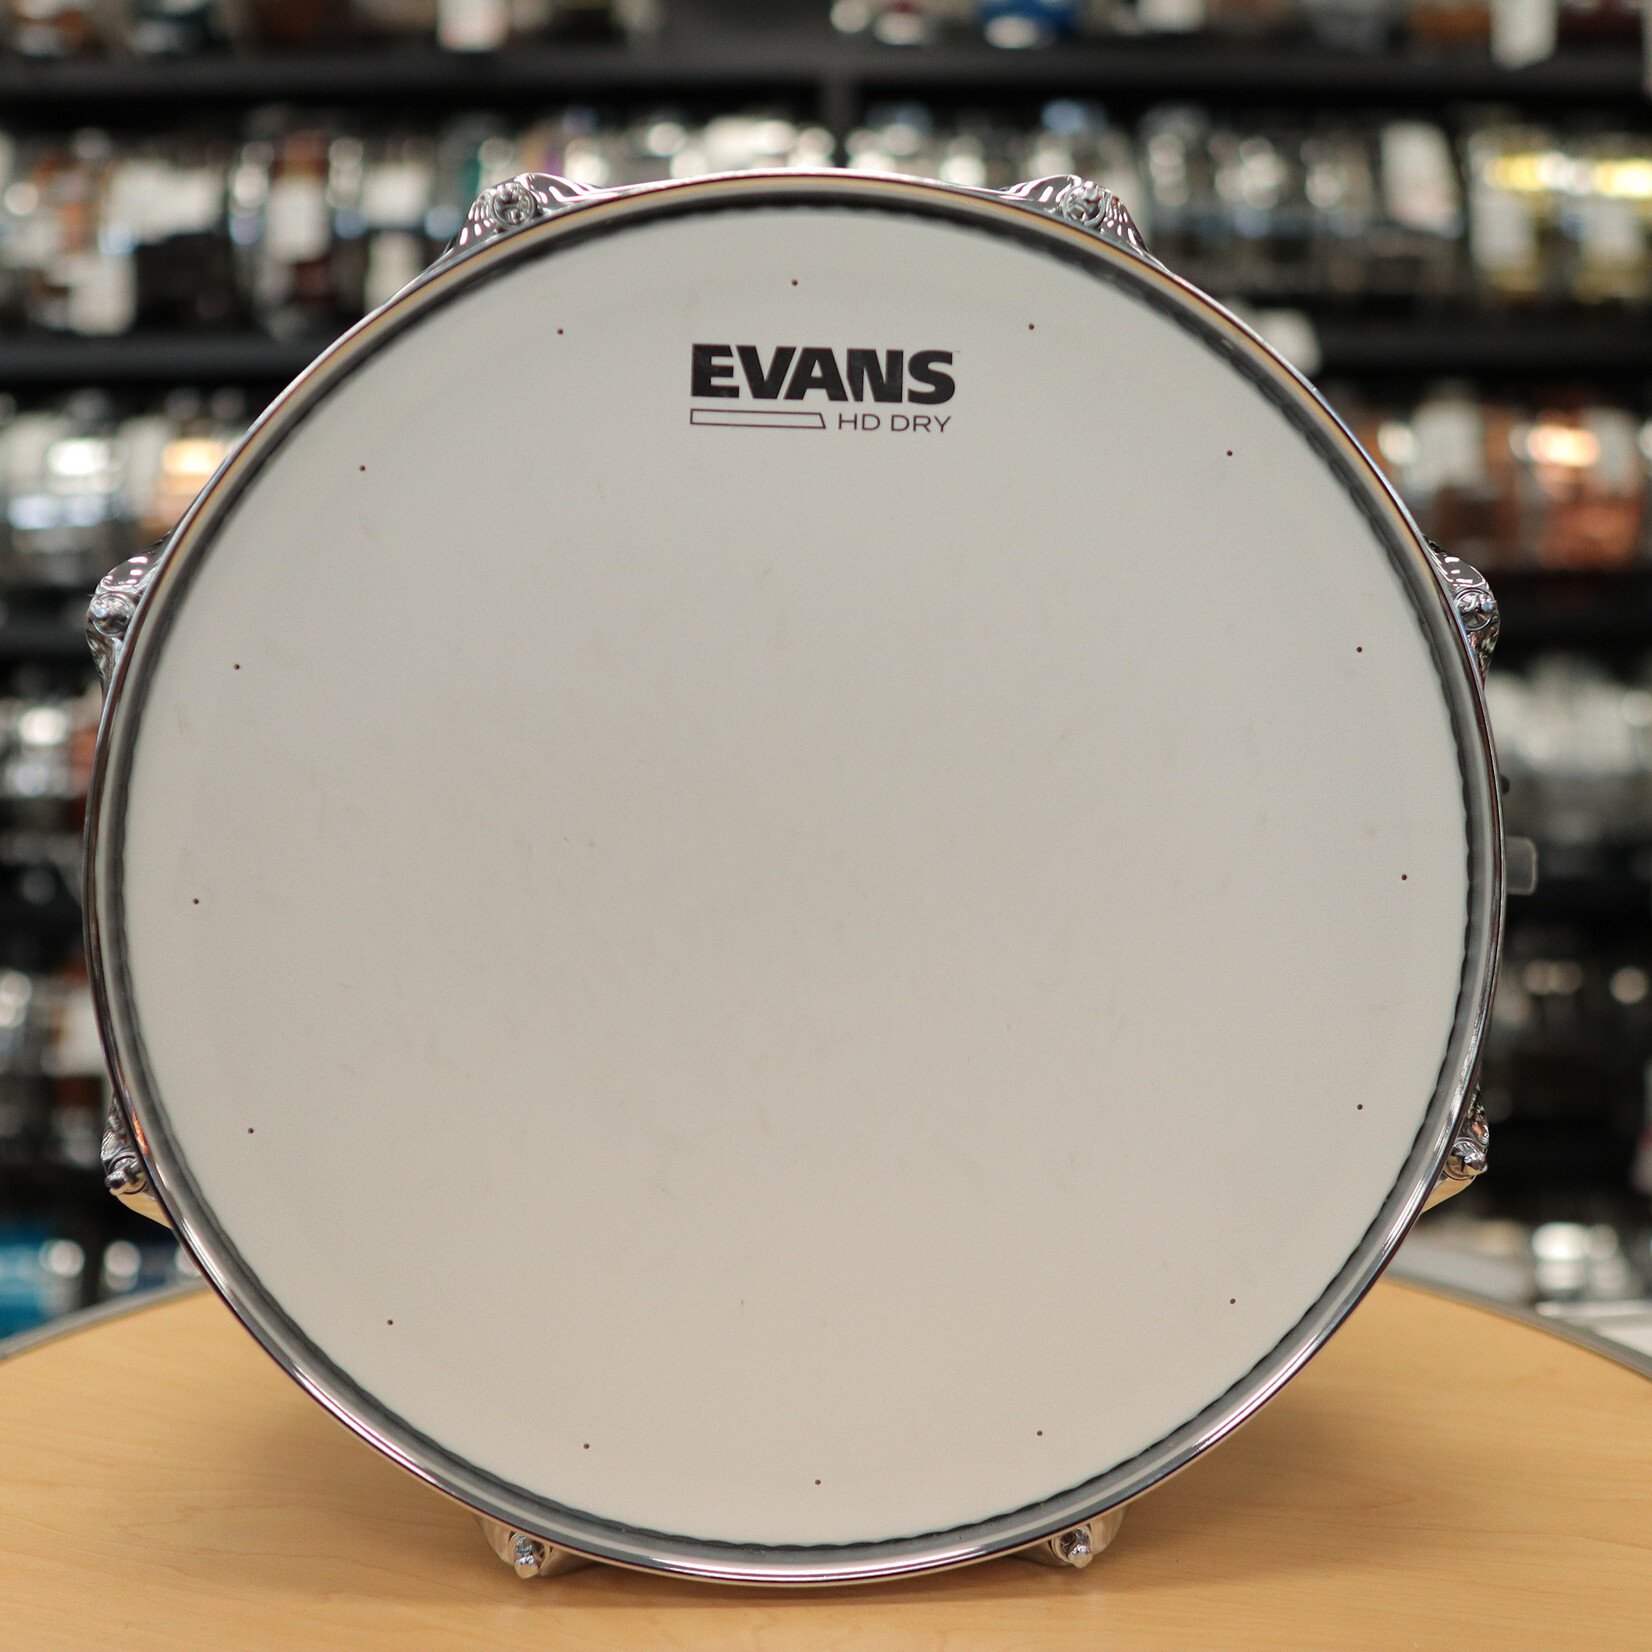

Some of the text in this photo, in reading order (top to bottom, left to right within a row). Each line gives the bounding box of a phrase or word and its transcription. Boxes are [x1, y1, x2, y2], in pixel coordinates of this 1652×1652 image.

[691, 343, 956, 405] EVANS
[838, 413, 951, 433] HD DRY
